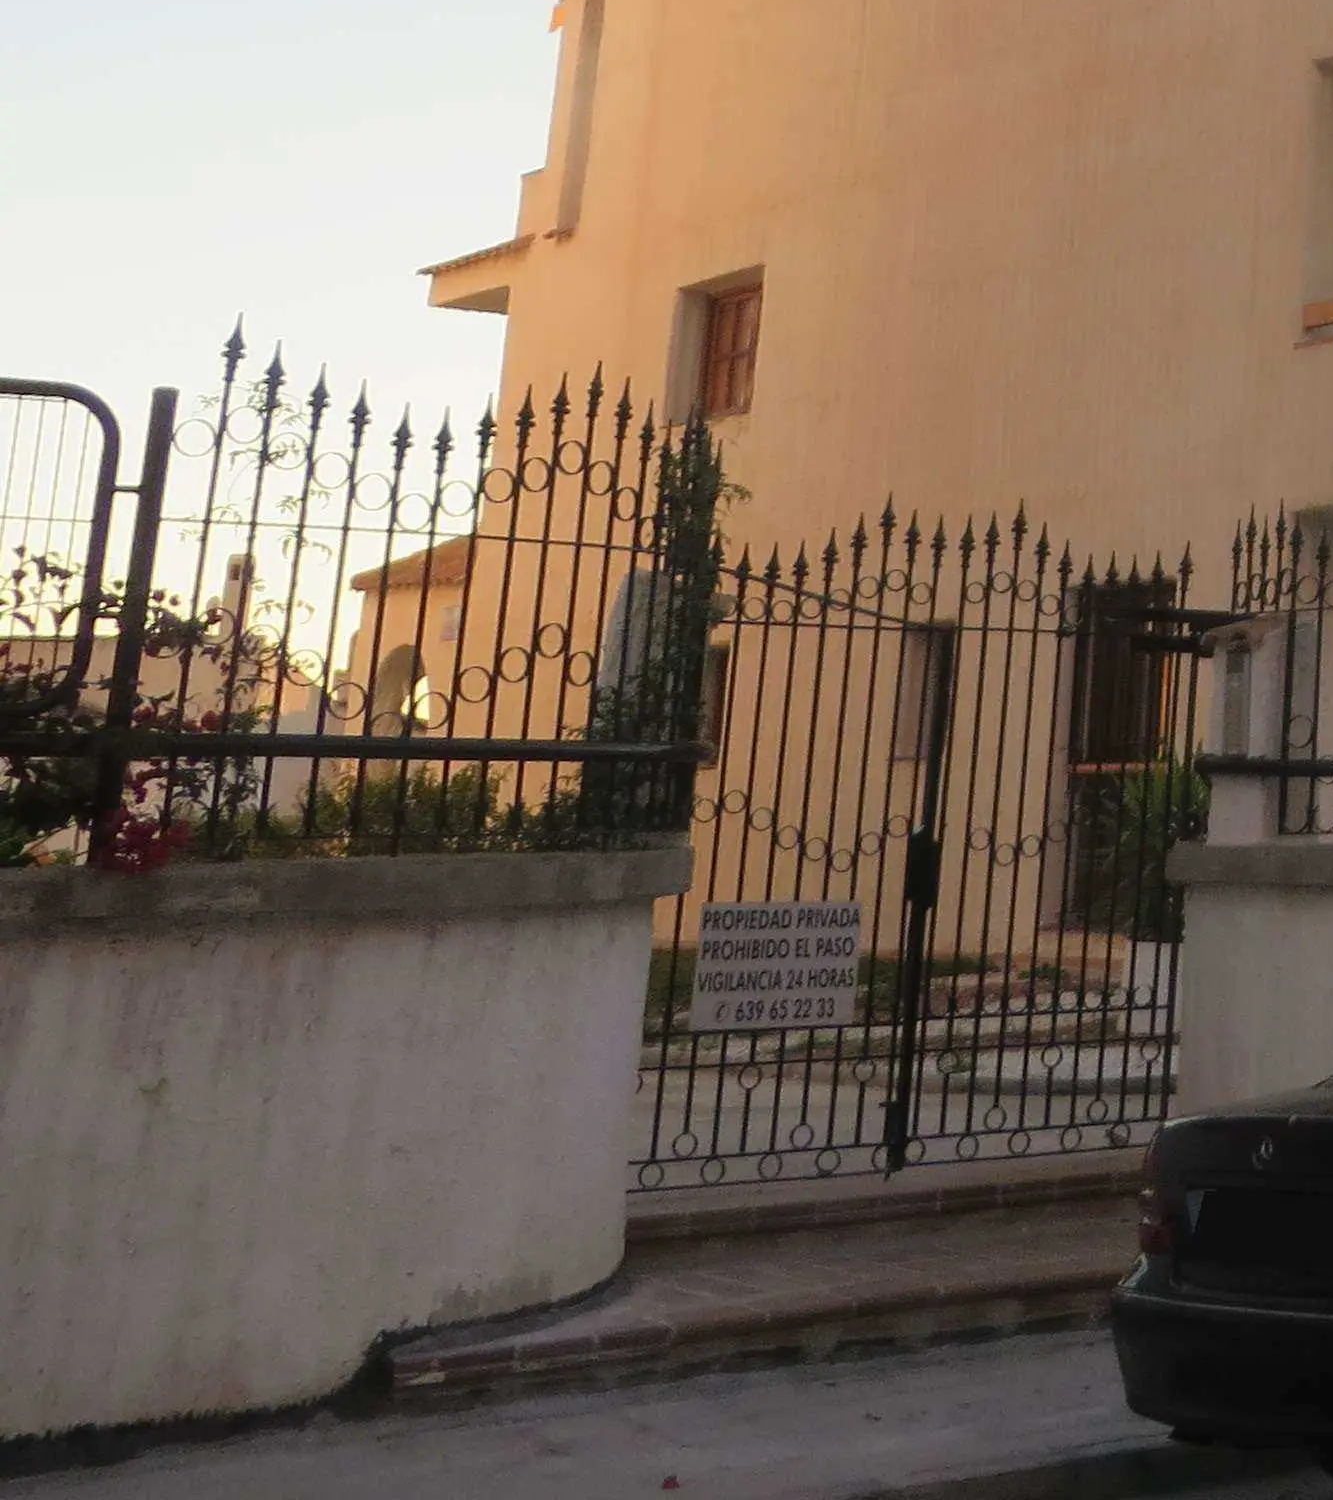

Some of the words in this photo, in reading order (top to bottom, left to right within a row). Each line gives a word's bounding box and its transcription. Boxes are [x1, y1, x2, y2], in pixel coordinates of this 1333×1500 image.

[702, 910, 792, 931] PROPIEDAD
[796, 907, 860, 929] PRIVADA
[701, 938, 790, 960] PROHIBIDO
[795, 937, 810, 958] EL
[815, 936, 855, 957] PASO
[698, 969, 781, 992] VIGILANCIA
[785, 969, 804, 990] 24
[807, 967, 854, 988] HORAS
[735, 1001, 765, 1021] 639
[769, 1000, 788, 1020] 65
[793, 999, 813, 1019] 22
[817, 997, 836, 1018] 33
